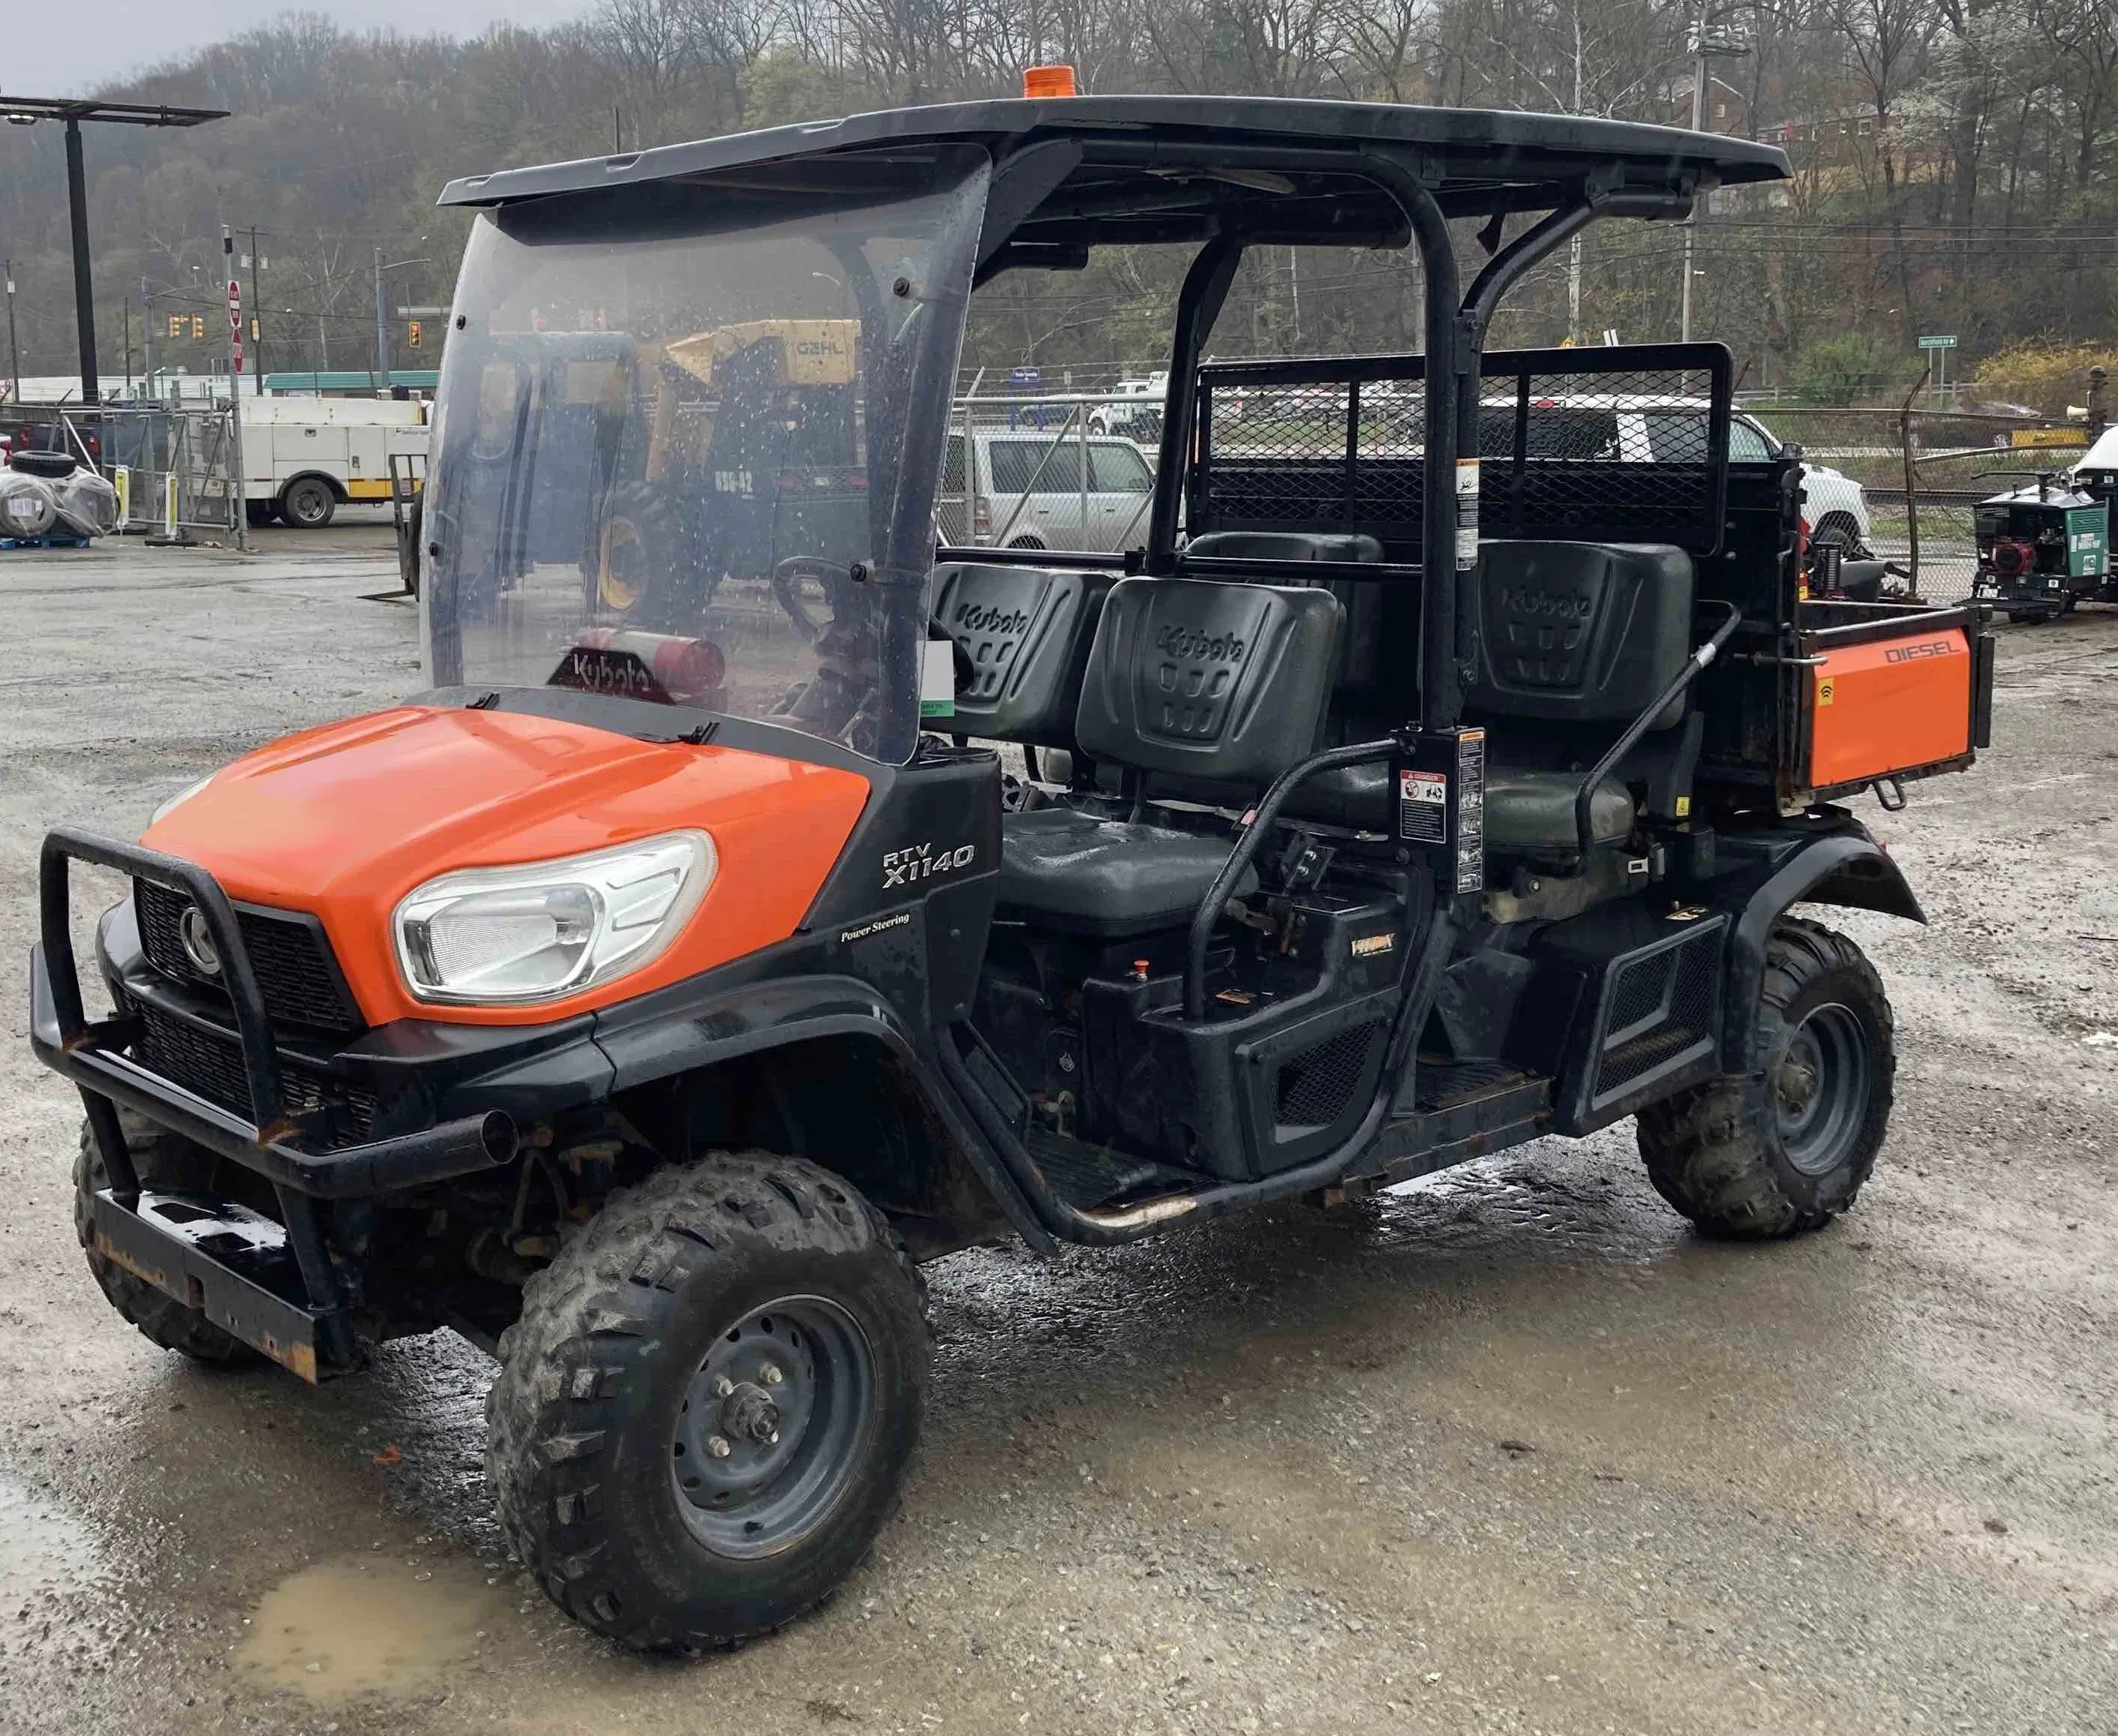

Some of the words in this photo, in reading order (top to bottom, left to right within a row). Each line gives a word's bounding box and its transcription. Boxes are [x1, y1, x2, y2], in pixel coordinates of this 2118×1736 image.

[797, 342, 843, 356] GEHL
[956, 603, 1027, 633] Kubota
[1156, 626, 1244, 662] Kubota
[1885, 641, 1960, 663] DIESEL
[572, 653, 650, 692] Kubota
[882, 845, 975, 888] X1140
[883, 842, 931, 867] RTV
[841, 927, 871, 942] Power
[872, 914, 909, 933] Steering
